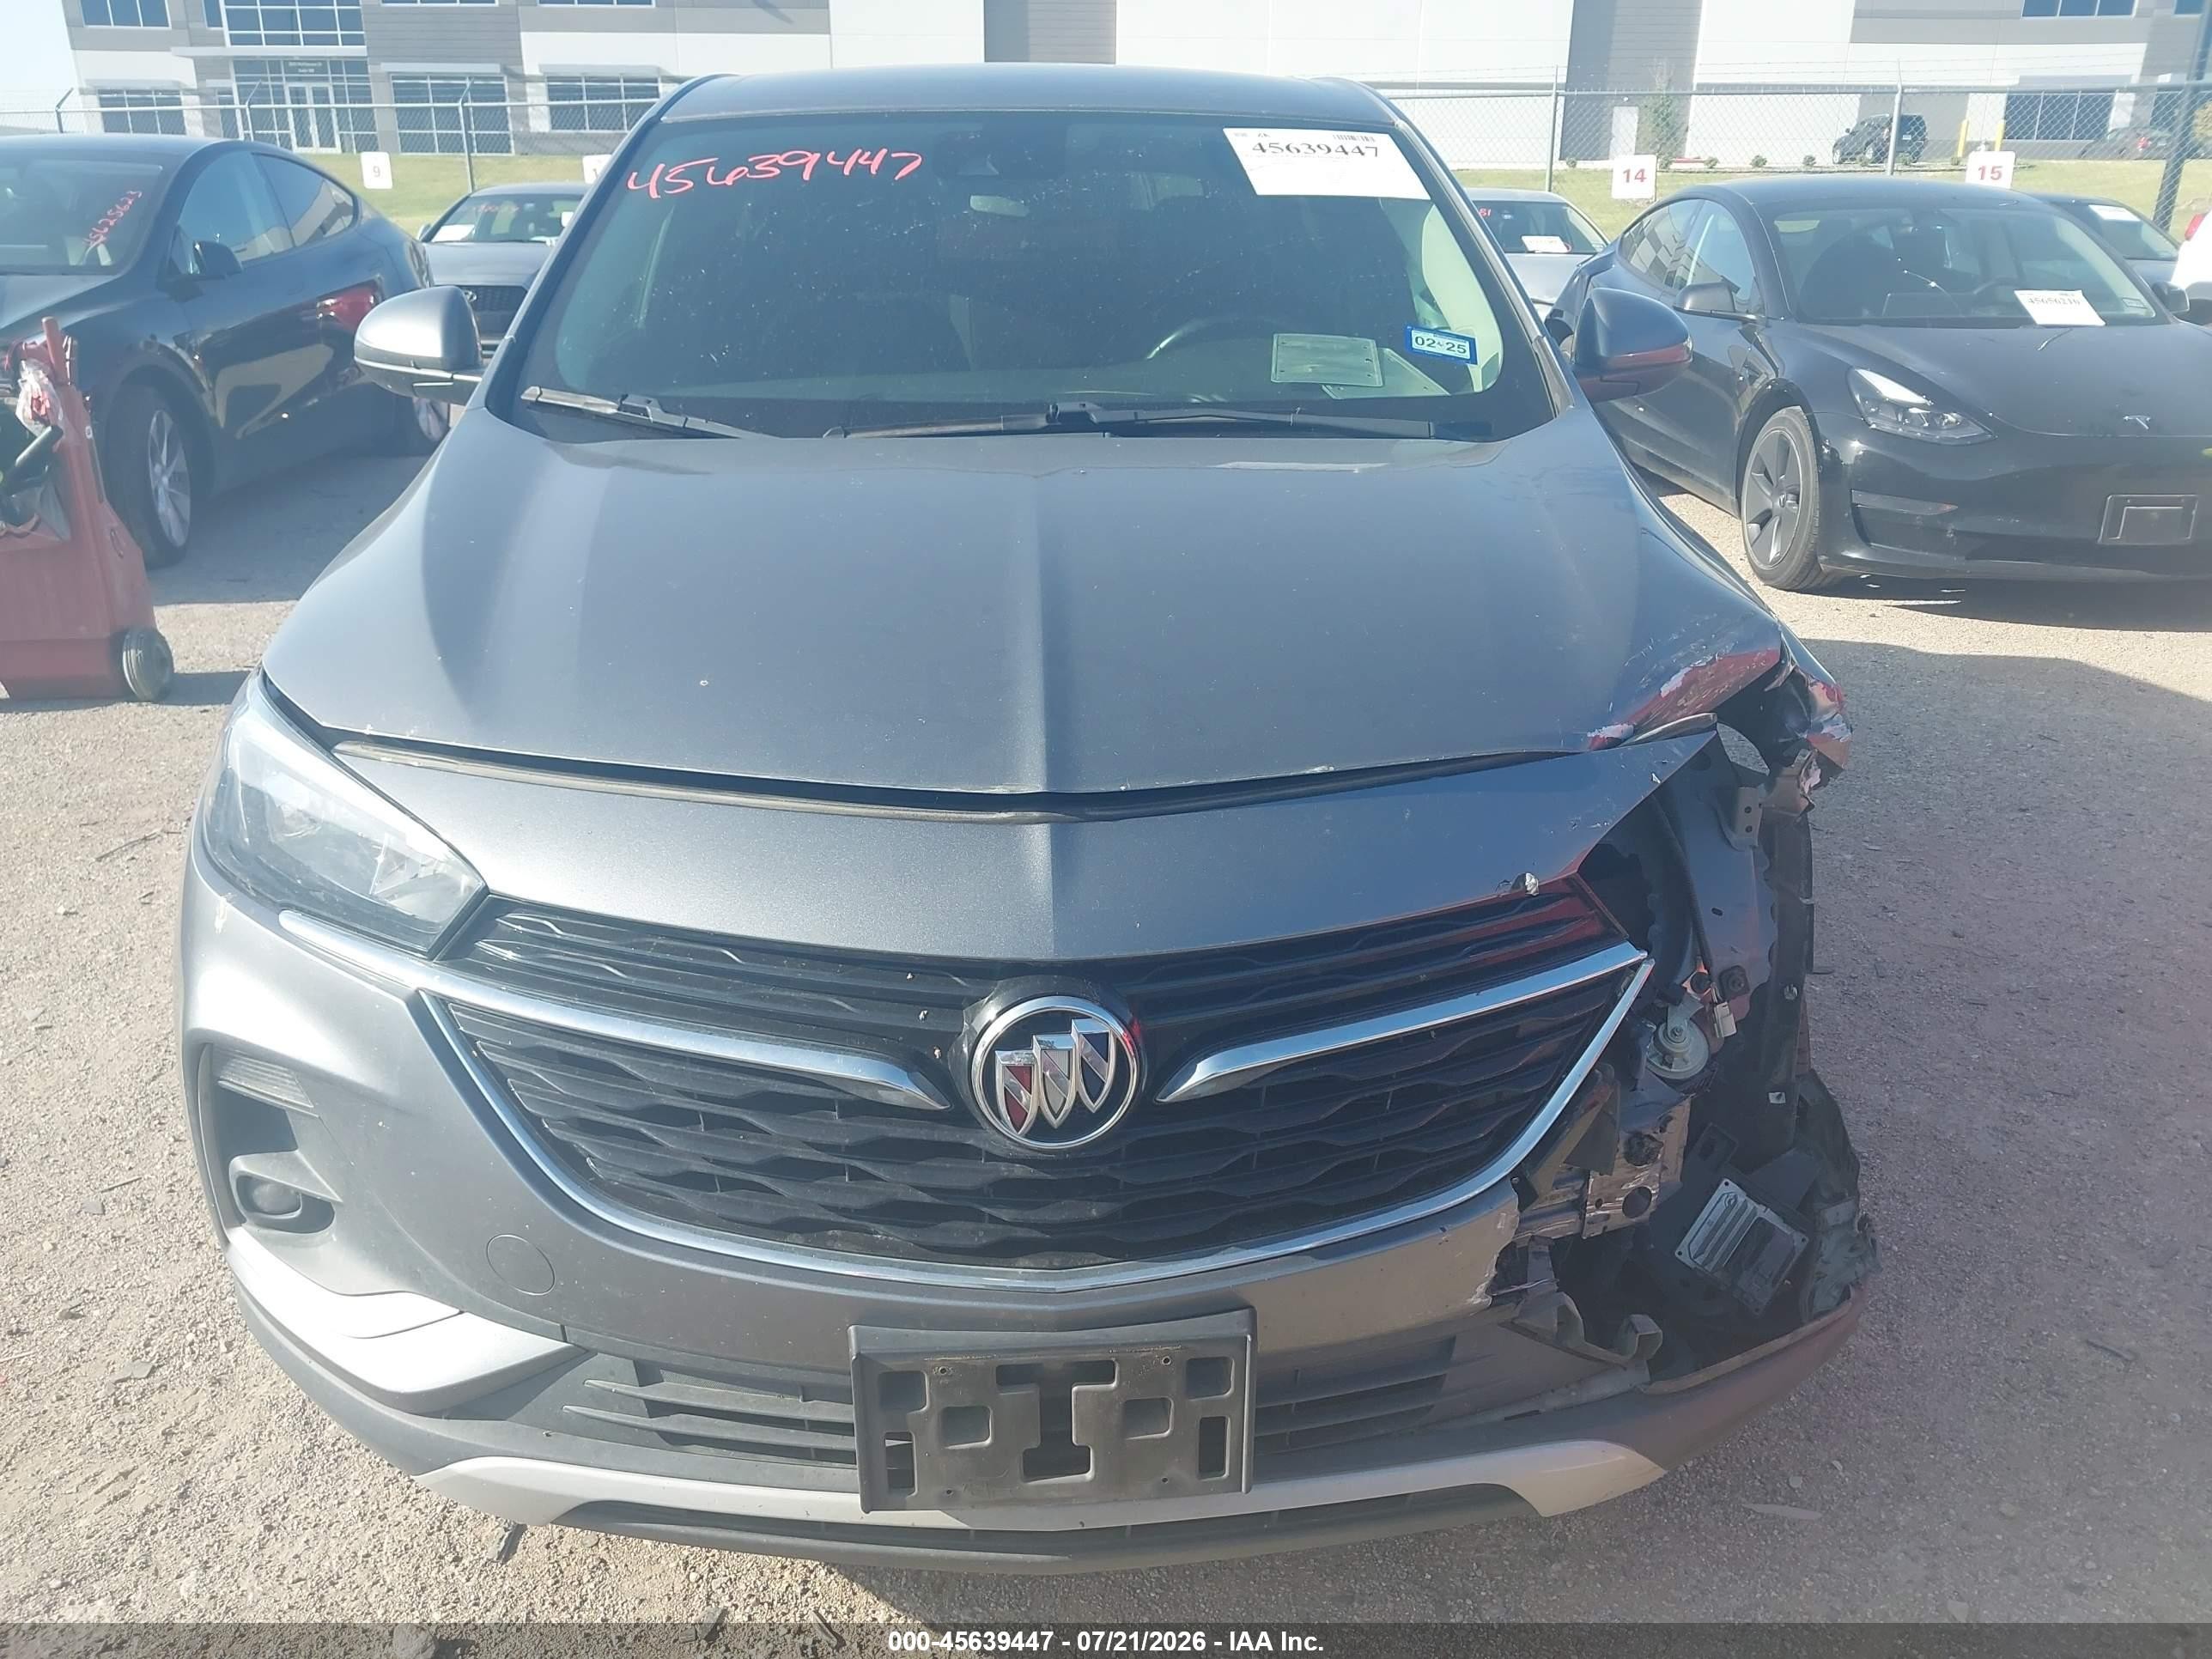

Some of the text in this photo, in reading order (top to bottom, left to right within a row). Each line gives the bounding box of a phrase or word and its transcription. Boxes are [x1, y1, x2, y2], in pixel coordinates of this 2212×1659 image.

[1252, 143, 1378, 157] 45639447
[627, 149, 922, 198] 45639447
[1622, 168, 1647, 183] 14
[1978, 165, 2003, 180] 15
[1414, 336, 1437, 349] 02
[1445, 342, 1468, 354] 25
